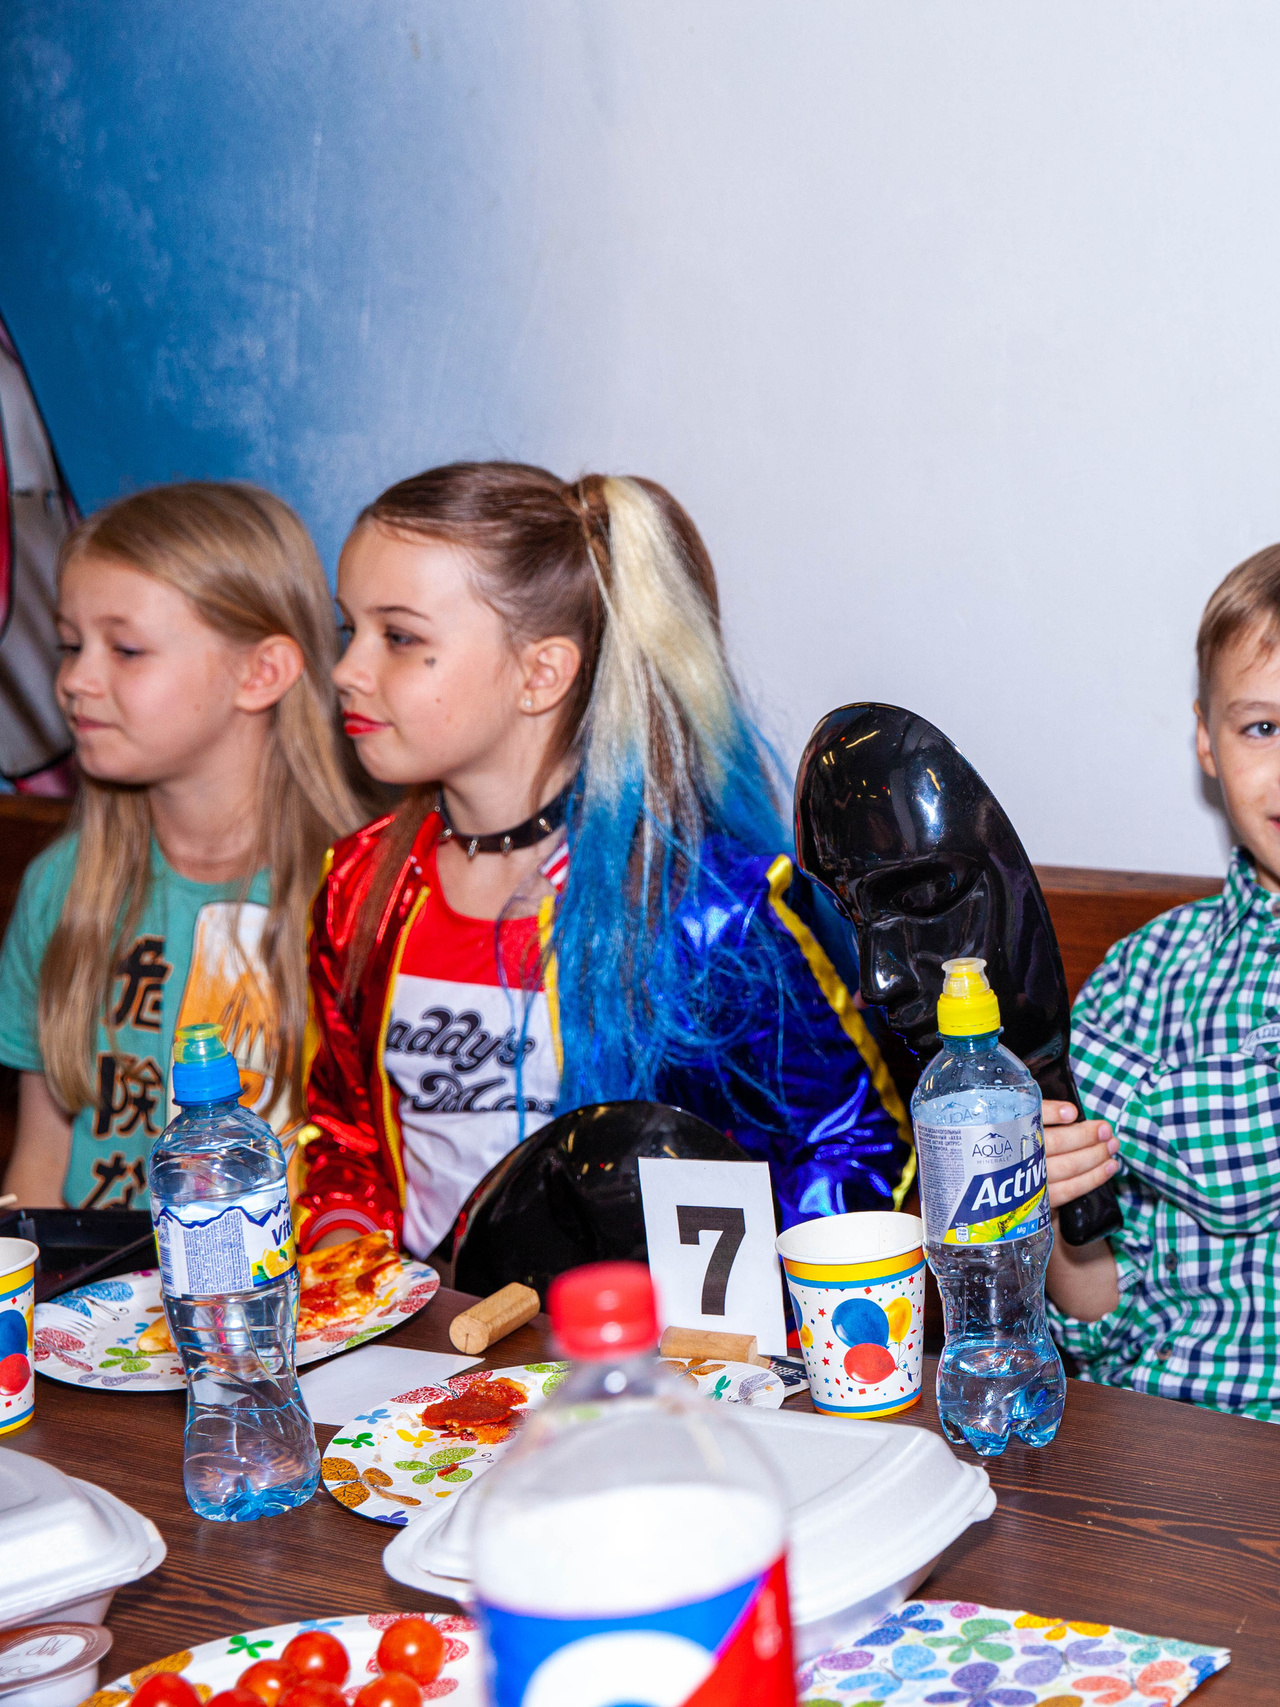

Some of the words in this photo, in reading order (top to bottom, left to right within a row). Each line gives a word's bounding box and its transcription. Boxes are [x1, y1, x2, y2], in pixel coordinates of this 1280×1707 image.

[386, 1006, 536, 1075] addy's
[972, 1139, 1014, 1158] AQUA
[676, 1204, 747, 1316] 7
